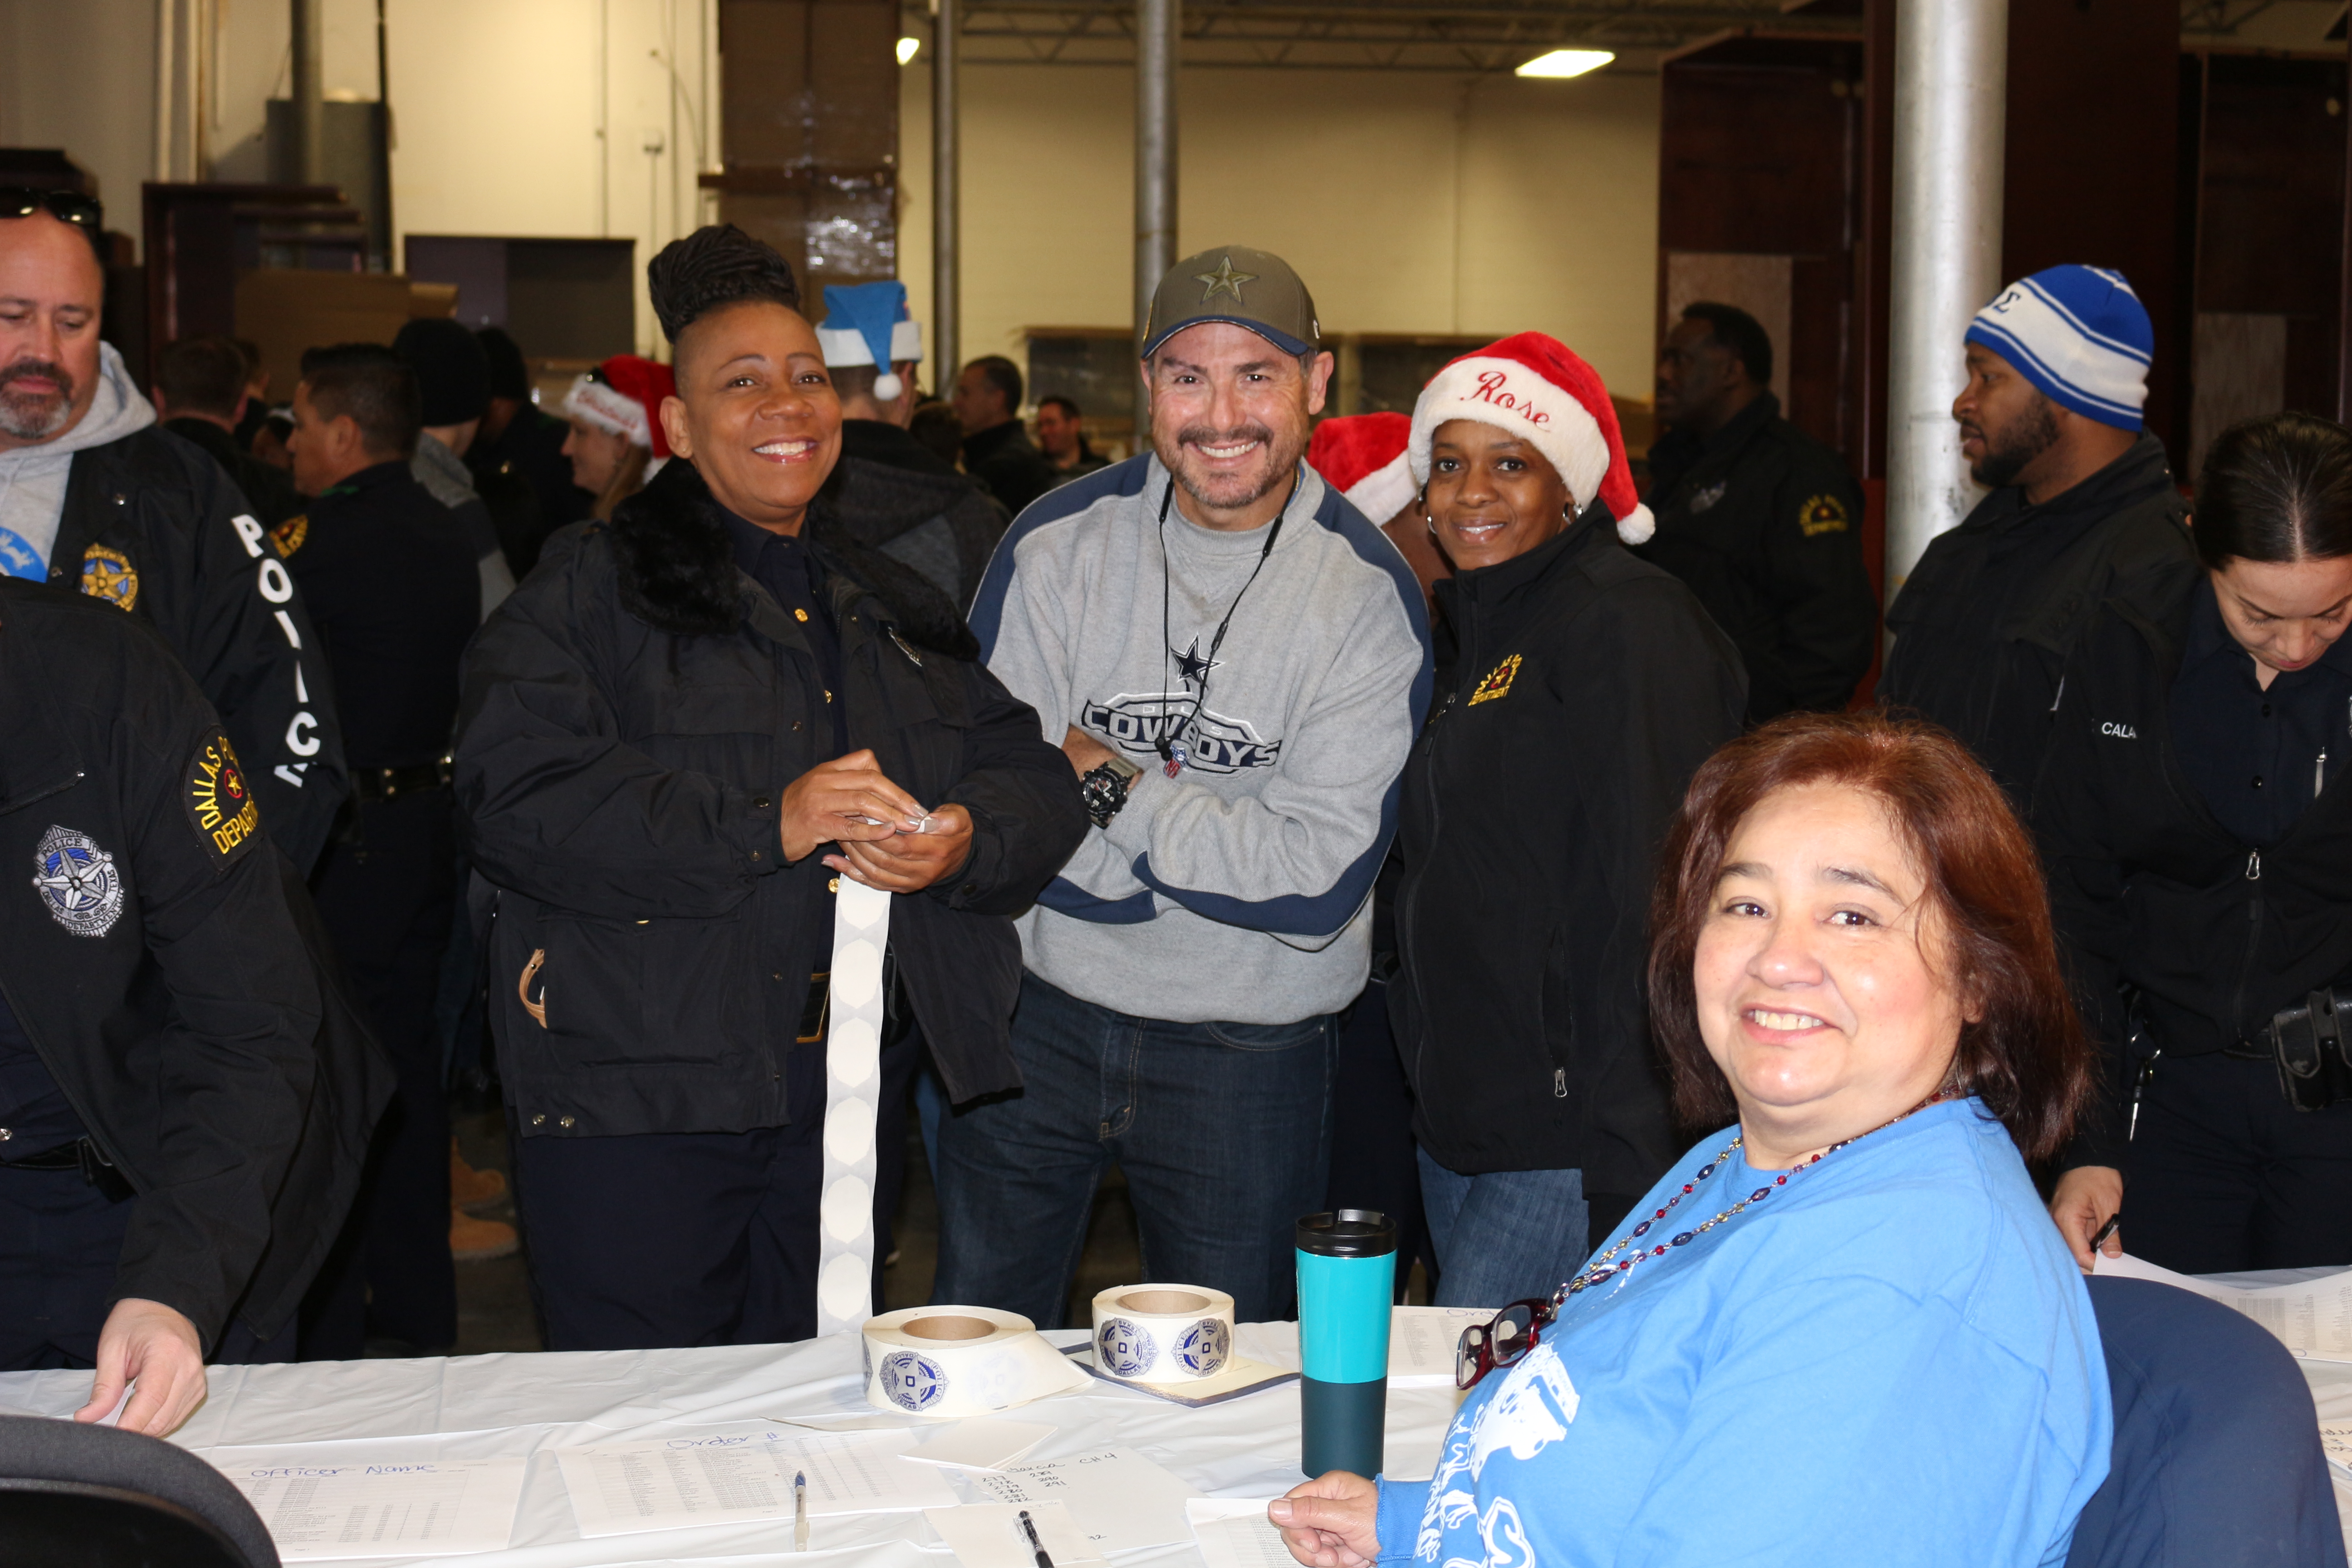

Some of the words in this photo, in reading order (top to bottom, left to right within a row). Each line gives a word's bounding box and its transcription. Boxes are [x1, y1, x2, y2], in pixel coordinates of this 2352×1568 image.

[1460, 371, 1550, 432] Rose
[1082, 699, 1282, 767] COWBOYS
[192, 745, 222, 830] DALLAS
[42, 838, 83, 857] POLICE
[107, 869, 118, 893] TEXAS
[68, 902, 122, 929] DEPARTMENT
[1118, 1342, 1127, 1354] D
[1177, 1335, 1187, 1369] POLICE
[906, 1375, 915, 1387] D
[932, 1365, 943, 1400] POLICE
[667, 1436, 753, 1448] Order
[366, 1464, 441, 1475] Name
